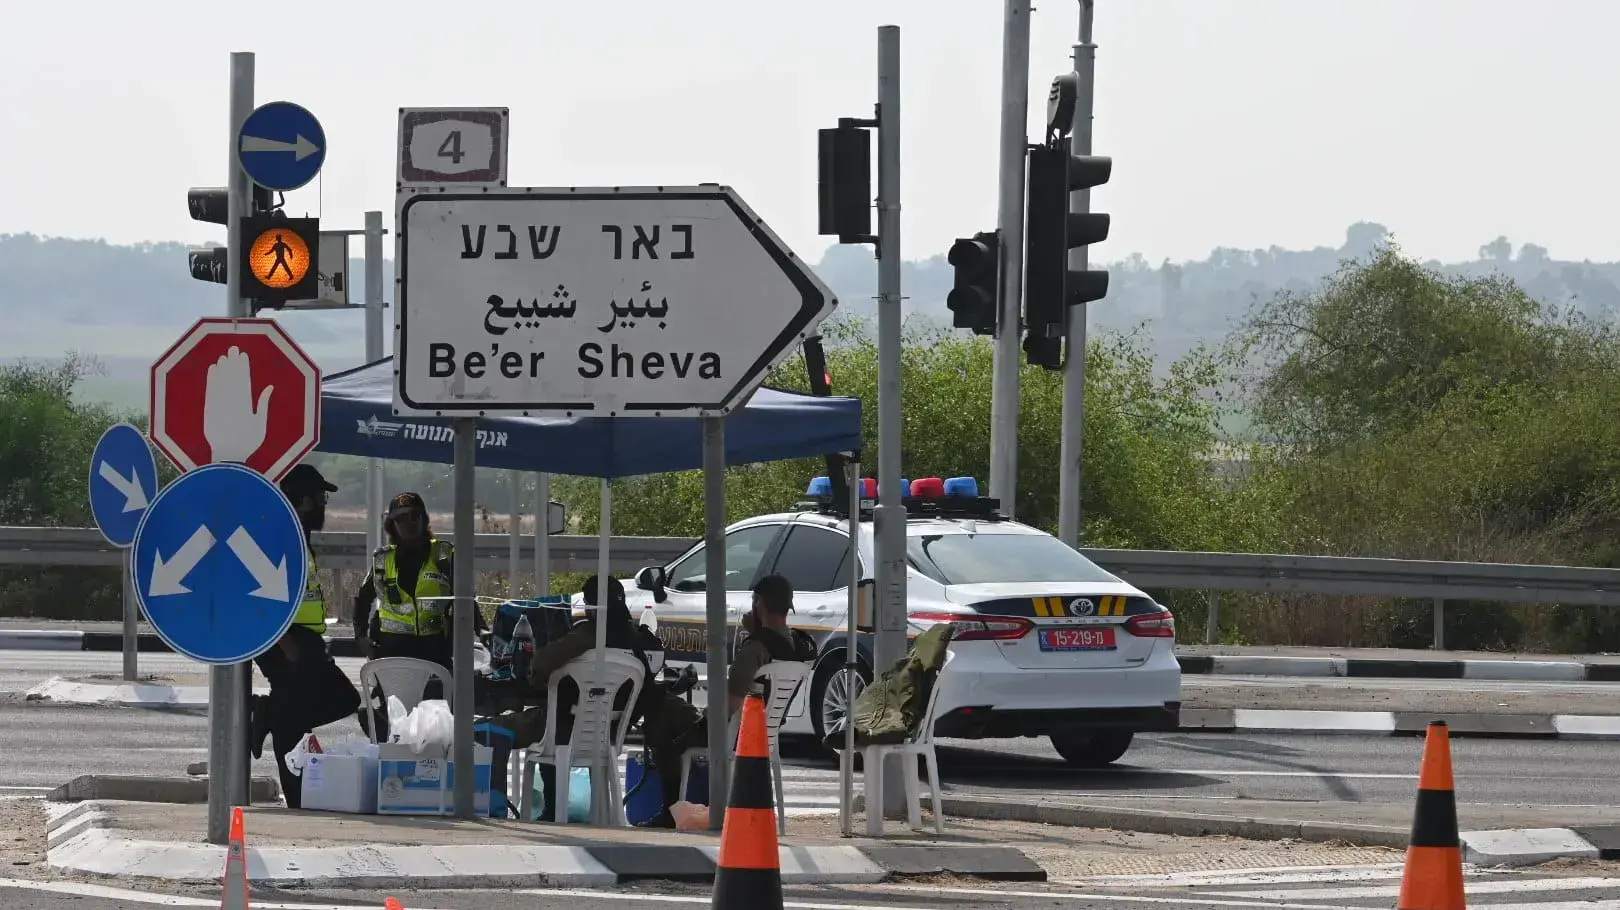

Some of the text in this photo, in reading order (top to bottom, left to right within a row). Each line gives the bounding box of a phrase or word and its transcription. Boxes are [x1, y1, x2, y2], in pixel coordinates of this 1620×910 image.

[437, 130, 466, 165] 4
[460, 224, 695, 260] באר שבע
[597, 280, 669, 334] بئير
[577, 342, 722, 380] Sheva
[404, 423, 455, 442] תנועה
[476, 429, 508, 449] אגף
